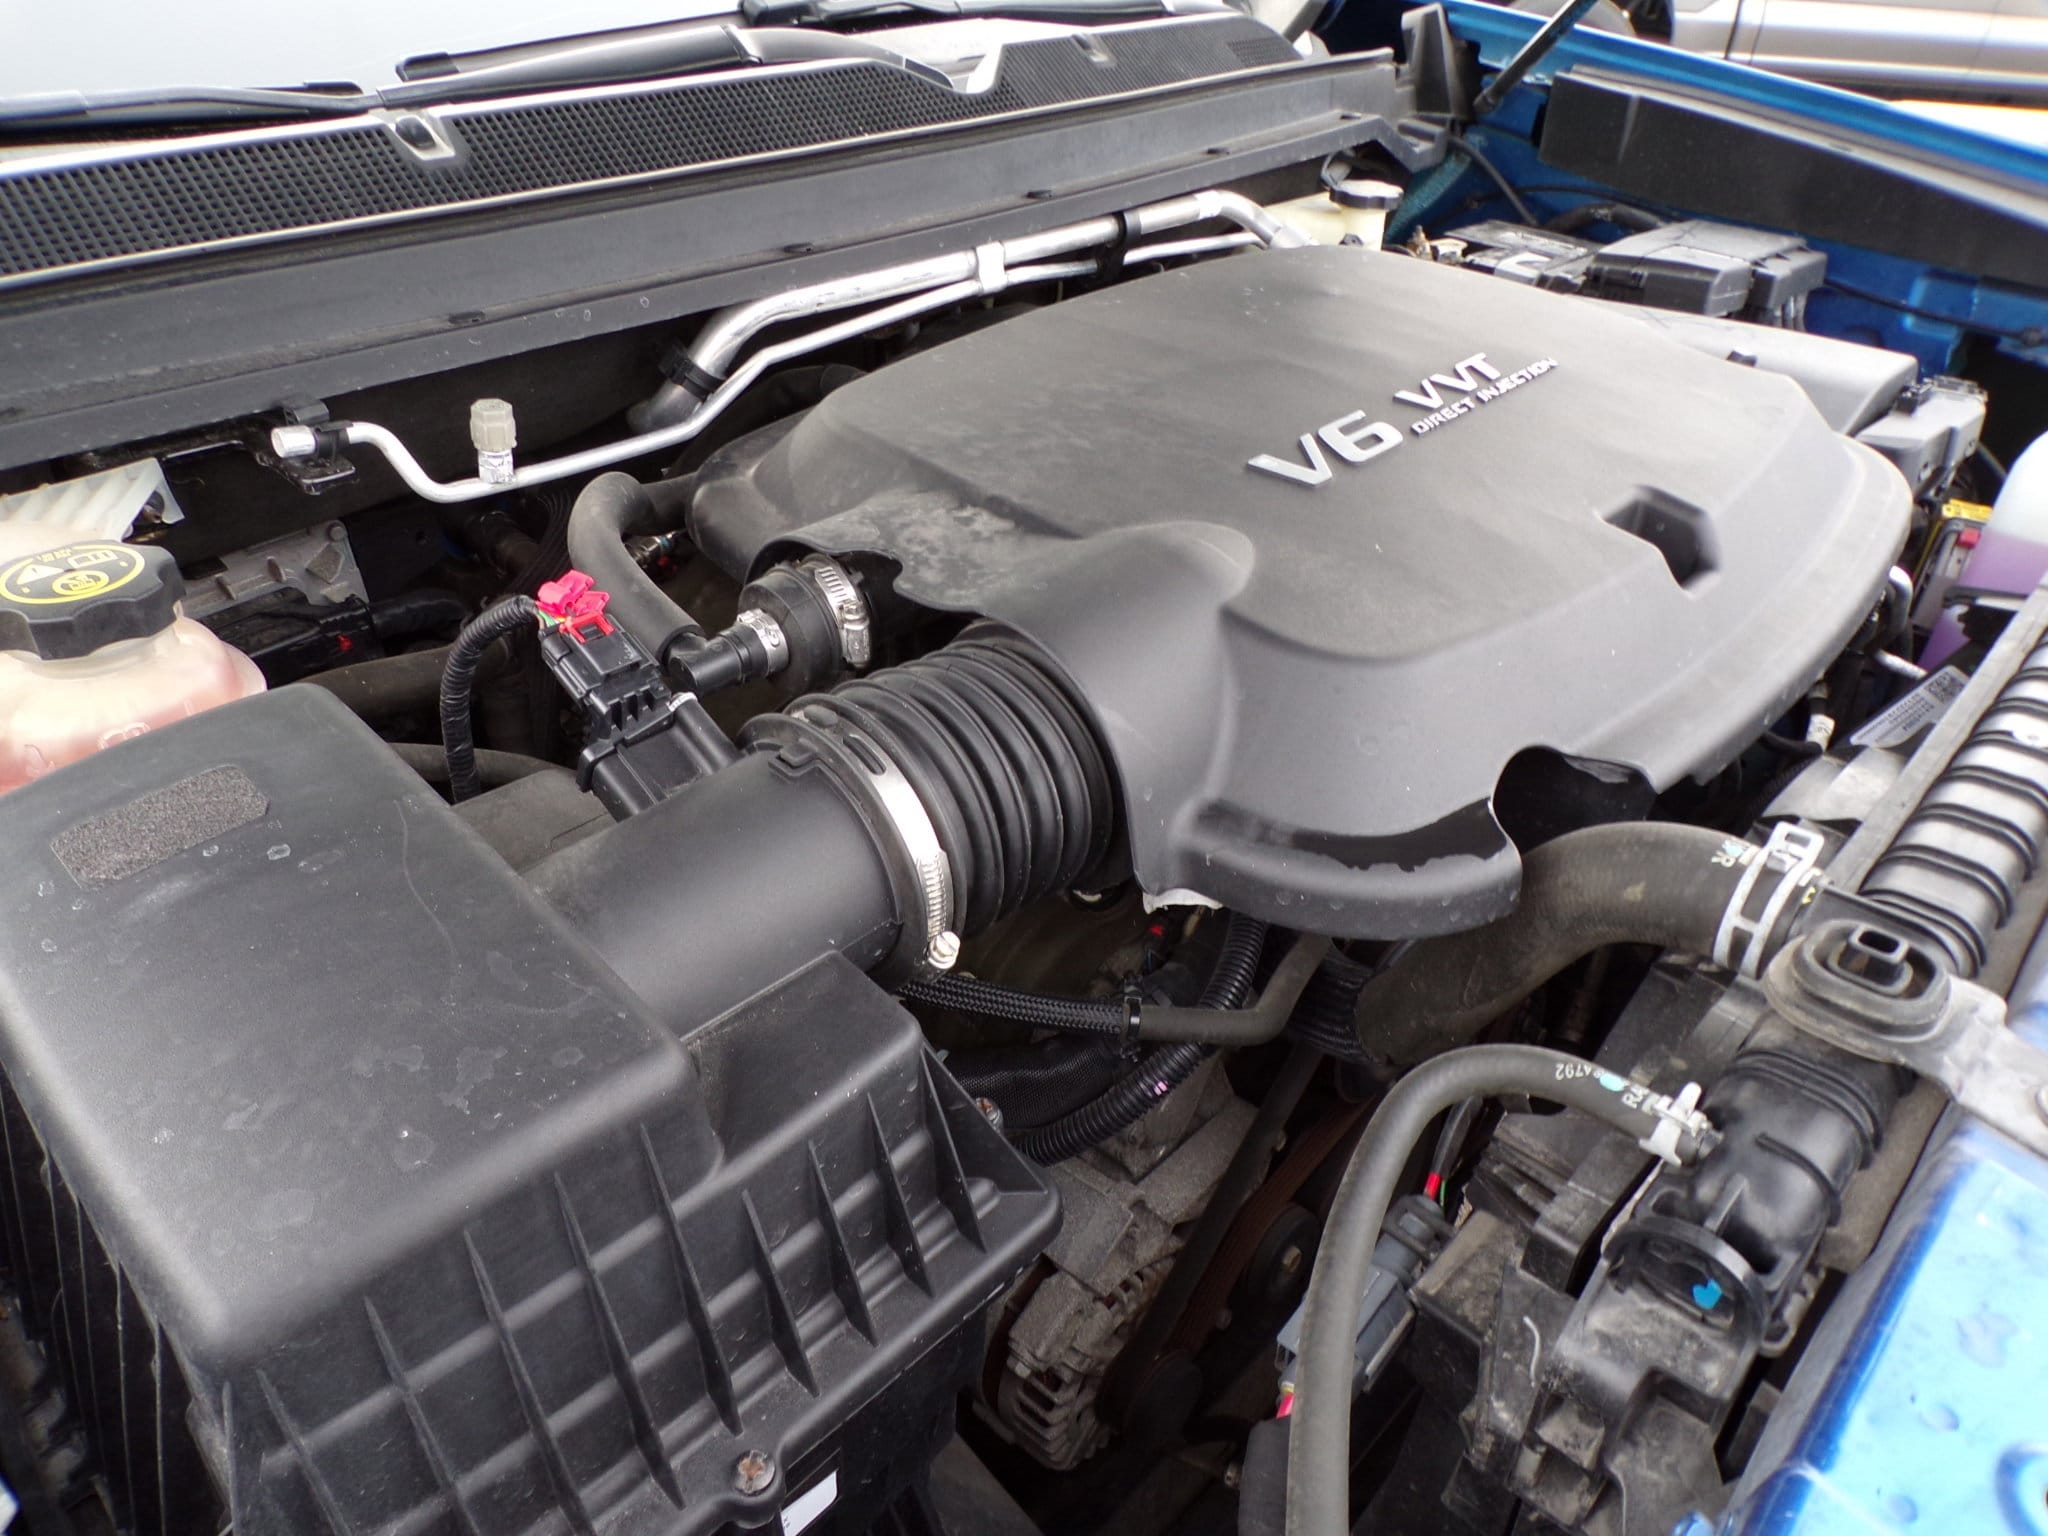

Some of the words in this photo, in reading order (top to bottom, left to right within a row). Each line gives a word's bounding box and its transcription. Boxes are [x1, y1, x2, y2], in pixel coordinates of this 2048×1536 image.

[1246, 409, 1405, 487] V6
[1392, 351, 1502, 410] VVT
[1409, 396, 1476, 436] DIRECT
[1474, 356, 1560, 405] INJECTION
